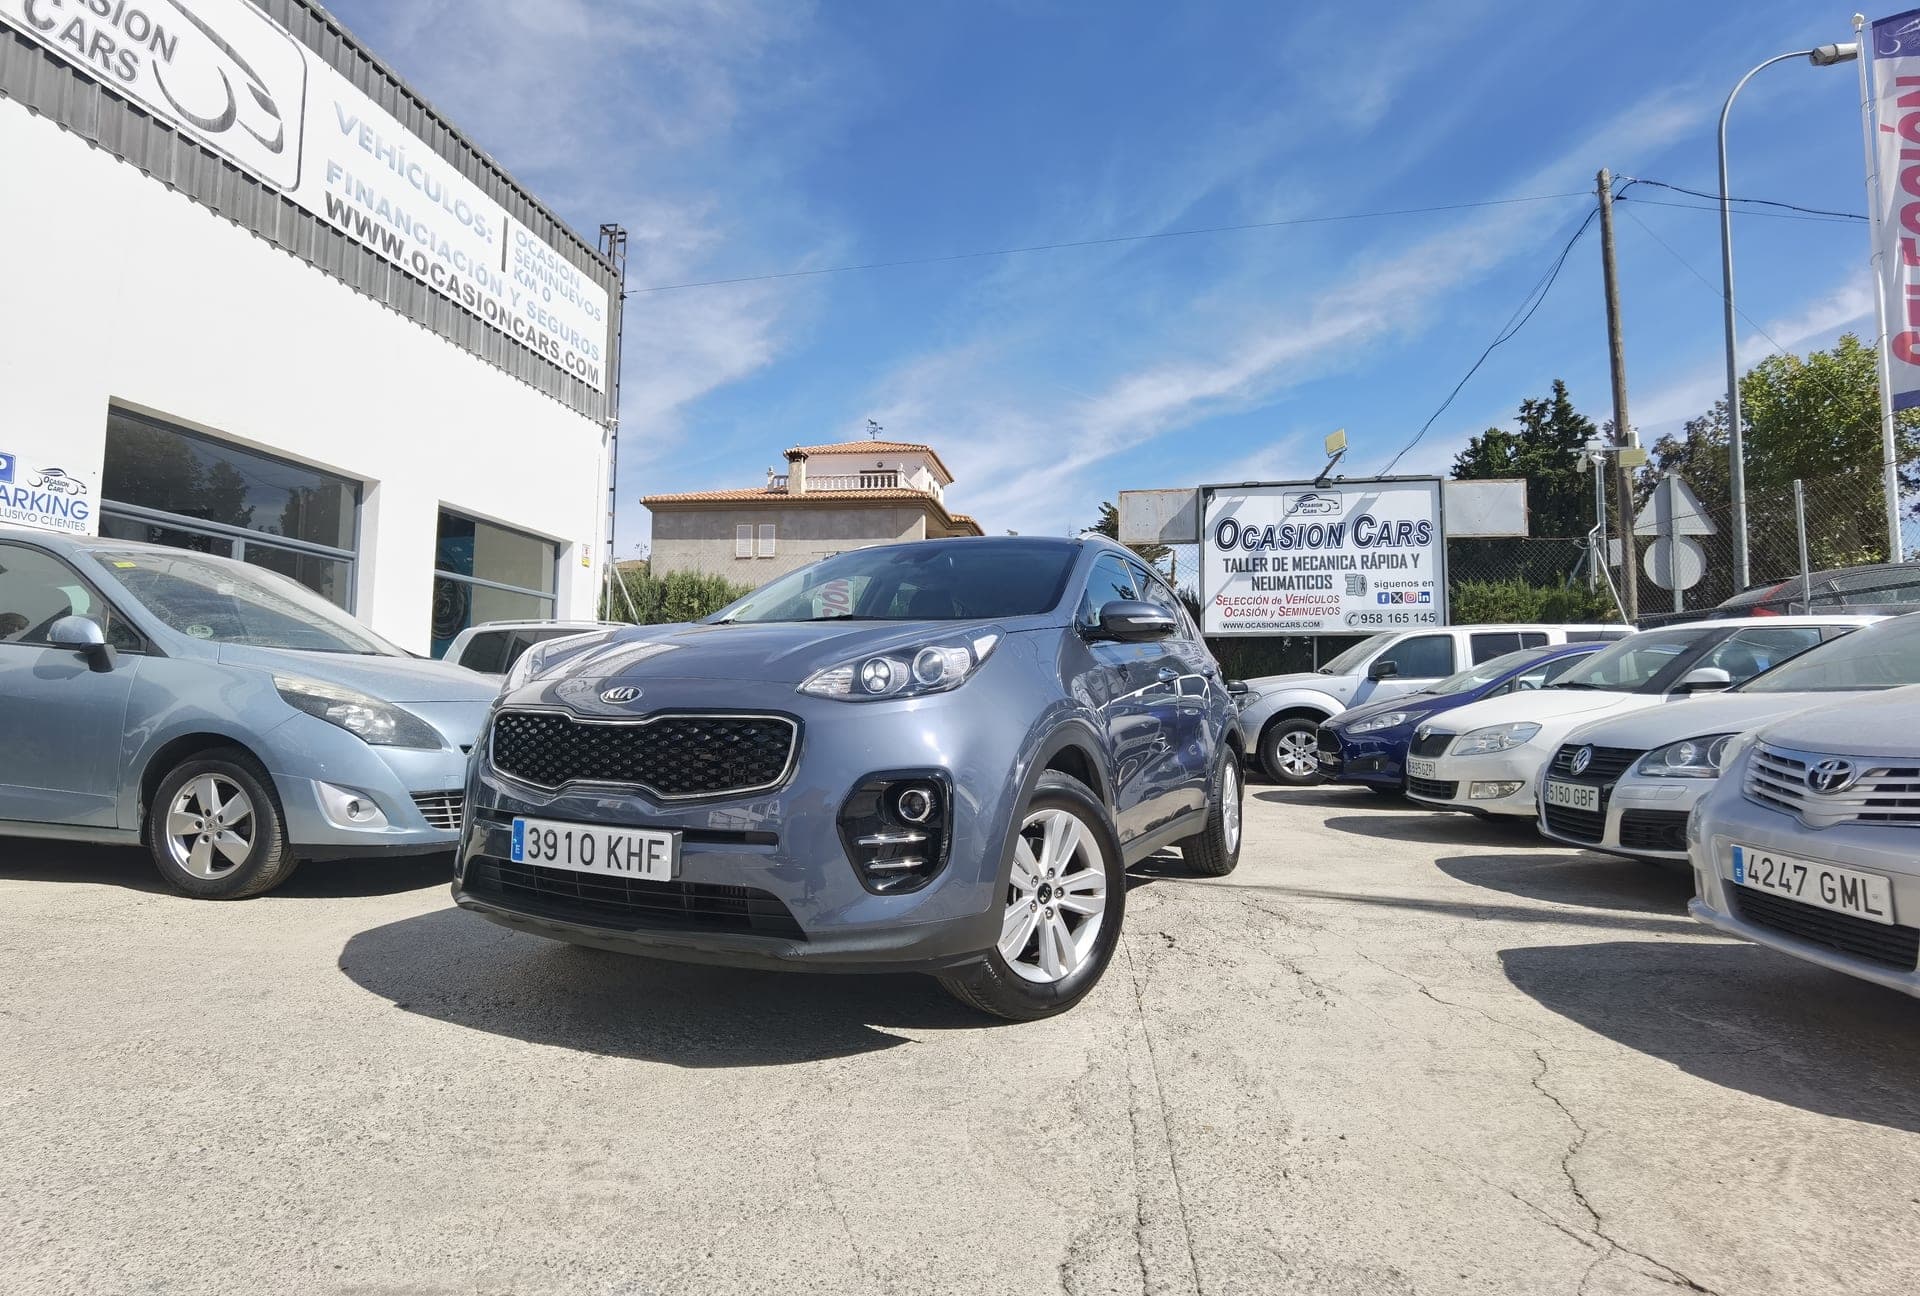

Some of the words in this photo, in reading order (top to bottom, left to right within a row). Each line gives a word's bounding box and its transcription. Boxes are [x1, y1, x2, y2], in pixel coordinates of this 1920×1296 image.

[24, 0, 139, 82] CARS
[326, 158, 503, 297] FINANCIACIÓN
[510, 287, 521, 307] Y
[526, 300, 600, 361] SEGUROS
[325, 190, 599, 385] WWW.OCASIONCARS.COM
[514, 264, 537, 294] KM
[514, 247, 601, 322] SEMINUEVOS
[0, 484, 89, 520] ARKING
[40, 515, 86, 532] CLIENTES
[1223, 557, 1268, 573] TALLER
[1272, 556, 1288, 572] DE
[1292, 554, 1357, 571] MECANICA
[1361, 551, 1408, 570] RÁPIDA
[1411, 553, 1420, 569] Y
[1251, 574, 1333, 591] NEUMATICOS
[1422, 580, 1434, 588] en
[1271, 595, 1282, 605] de
[1270, 608, 1276, 619] y
[1360, 613, 1383, 624] 958
[1388, 612, 1410, 624] 165
[1414, 612, 1436, 623] 145
[1223, 621, 1321, 630] WWW.OCASIONCARS.COM
[1549, 784, 1571, 804] 5150
[1573, 788, 1596, 807] GBF
[528, 827, 596, 866] 3910
[606, 835, 665, 873] KHF
[1748, 855, 1808, 896] 4247
[1820, 872, 1883, 916] GML
